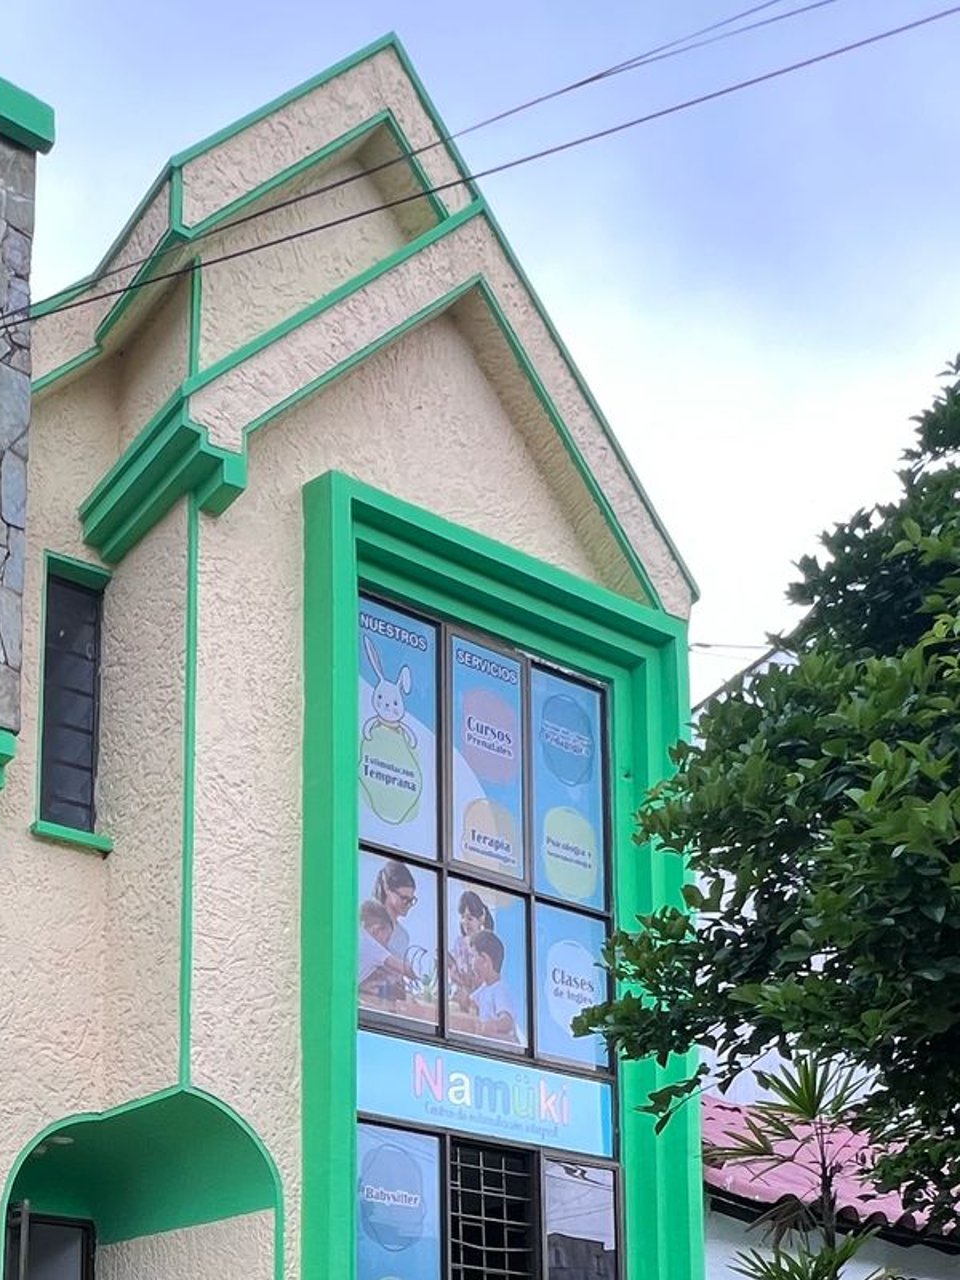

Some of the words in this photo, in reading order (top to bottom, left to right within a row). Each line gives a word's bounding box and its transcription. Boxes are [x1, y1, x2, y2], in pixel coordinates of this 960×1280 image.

[359, 613, 428, 651] NUESTROS
[456, 649, 517, 685] SERVICIOS
[467, 716, 512, 745] Cursos
[363, 764, 416, 791] Temprana
[551, 968, 594, 992] Clases
[413, 1051, 570, 1126] Namüki
[366, 1187, 418, 1205] Babysitter
